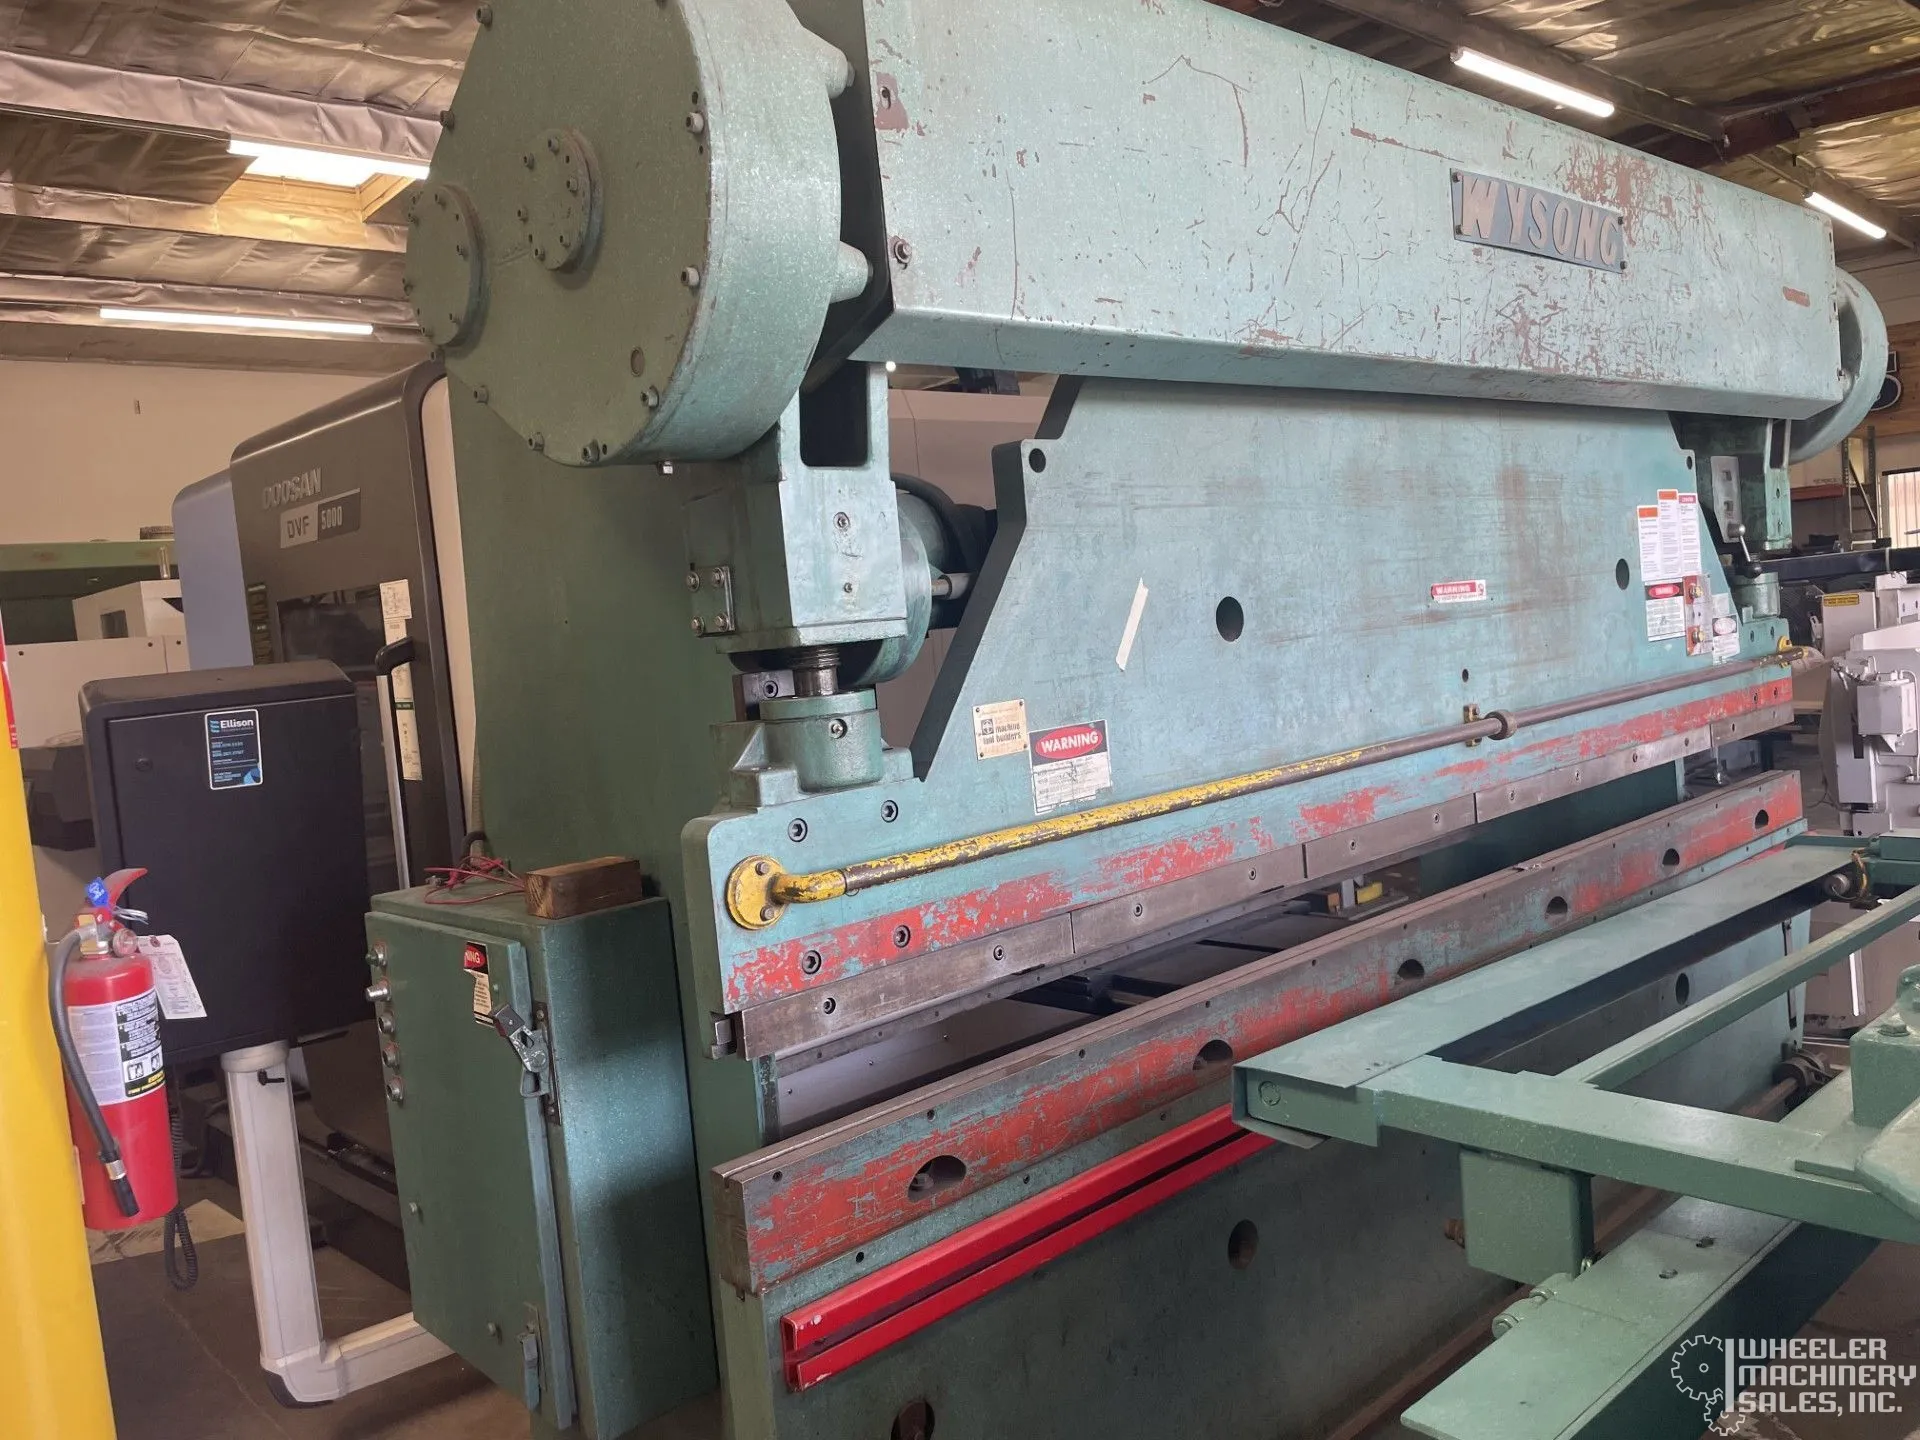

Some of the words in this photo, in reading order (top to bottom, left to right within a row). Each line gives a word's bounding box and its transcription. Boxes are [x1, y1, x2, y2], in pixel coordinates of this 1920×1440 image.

[1462, 175, 1618, 267] WYSONG
[262, 466, 321, 510] DOOSAN
[287, 516, 310, 539] DVF
[321, 506, 343, 530] 5000
[1435, 584, 1471, 595] WARNING
[220, 719, 254, 729] Ellison
[1041, 731, 1099, 753] WARNING
